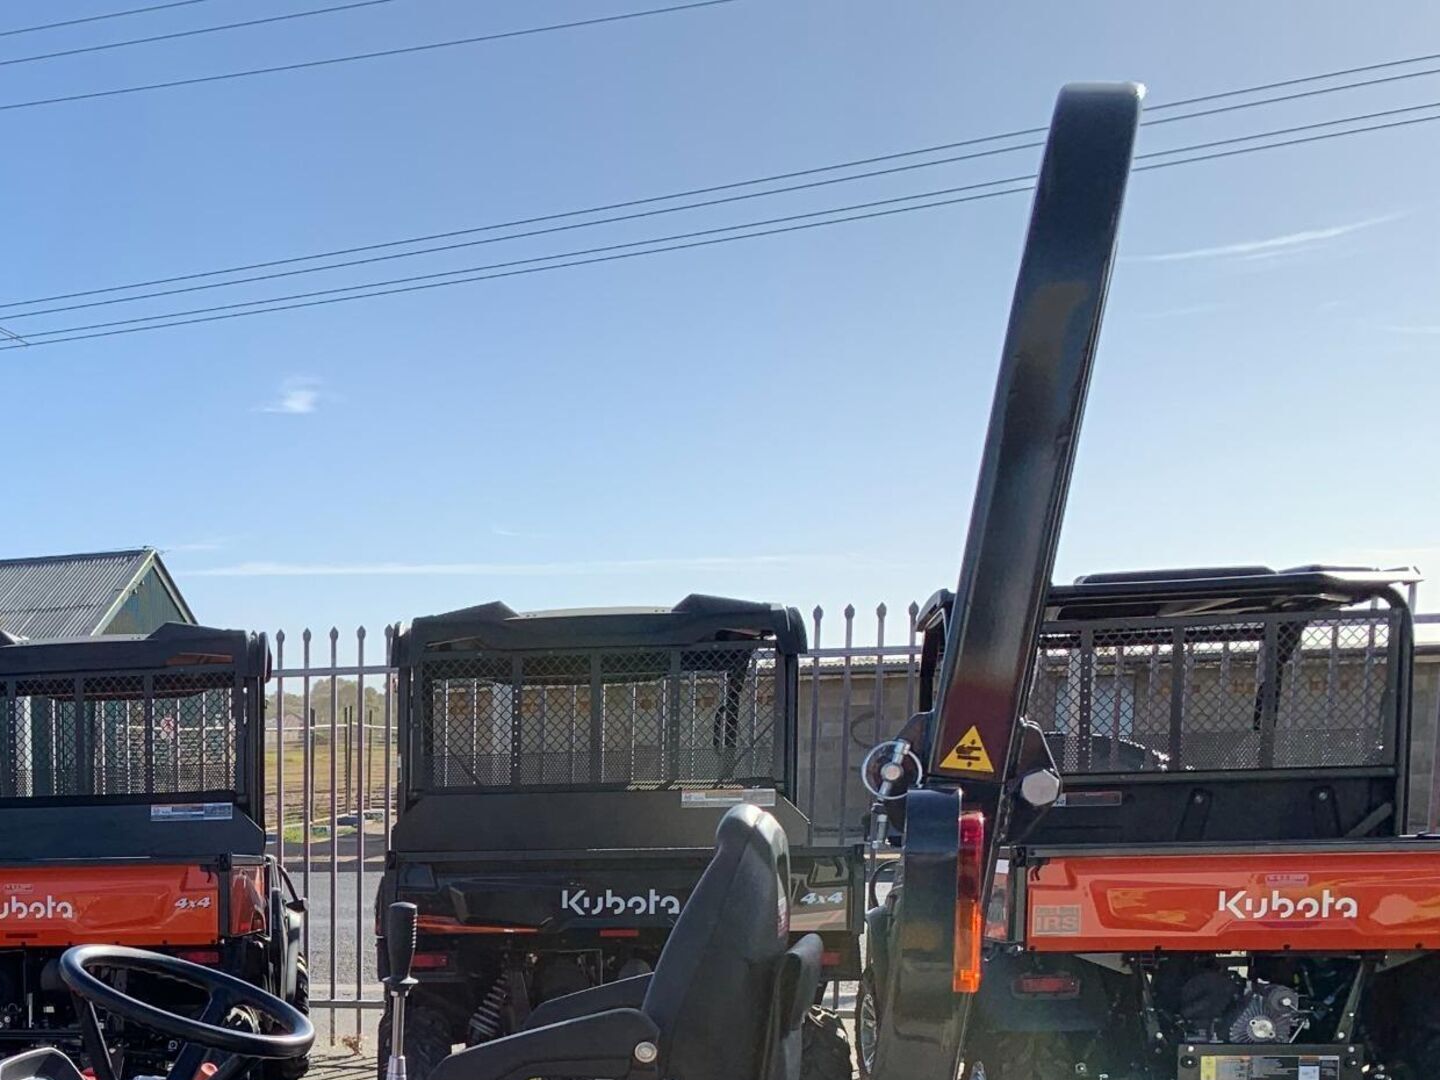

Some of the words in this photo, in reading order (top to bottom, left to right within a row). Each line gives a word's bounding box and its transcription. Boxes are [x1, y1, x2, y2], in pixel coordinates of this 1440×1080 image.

[174, 896, 211, 909] 4x4
[561, 889, 680, 916] Kubota
[800, 891, 844, 905] 4x4
[1218, 889, 1358, 919] Kubota
